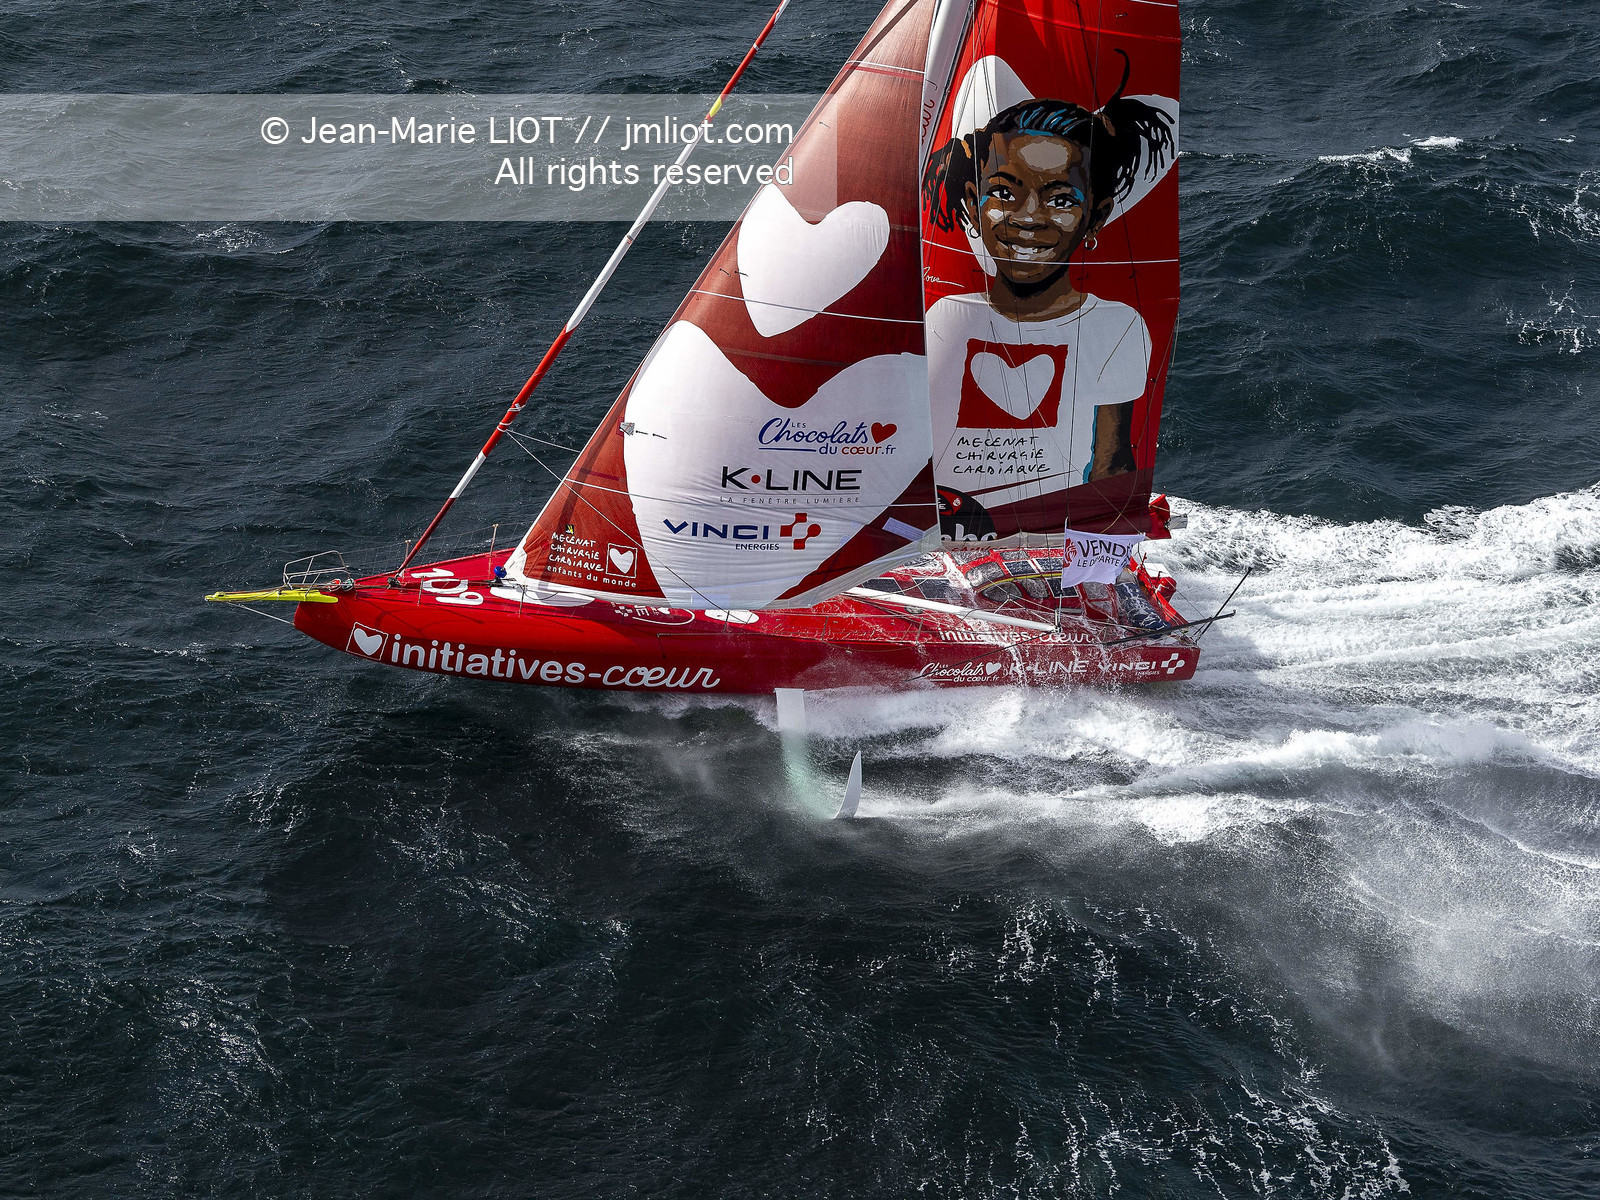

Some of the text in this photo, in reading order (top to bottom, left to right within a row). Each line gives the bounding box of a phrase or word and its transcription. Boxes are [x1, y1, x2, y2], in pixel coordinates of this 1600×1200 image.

[791, 421, 806, 429] LES
[758, 417, 869, 445] Chocolats
[956, 435, 1039, 448] MECENAT
[819, 444, 837, 455] du
[743, 496, 797, 505] FENÊTRE
[806, 496, 860, 504] LUMIÈRE
[662, 518, 770, 540] VINCI
[735, 543, 780, 551] ENERGIES
[1077, 558, 1087, 568] LE
[547, 565, 637, 588] enfants du monde
[953, 674, 965, 683] du
